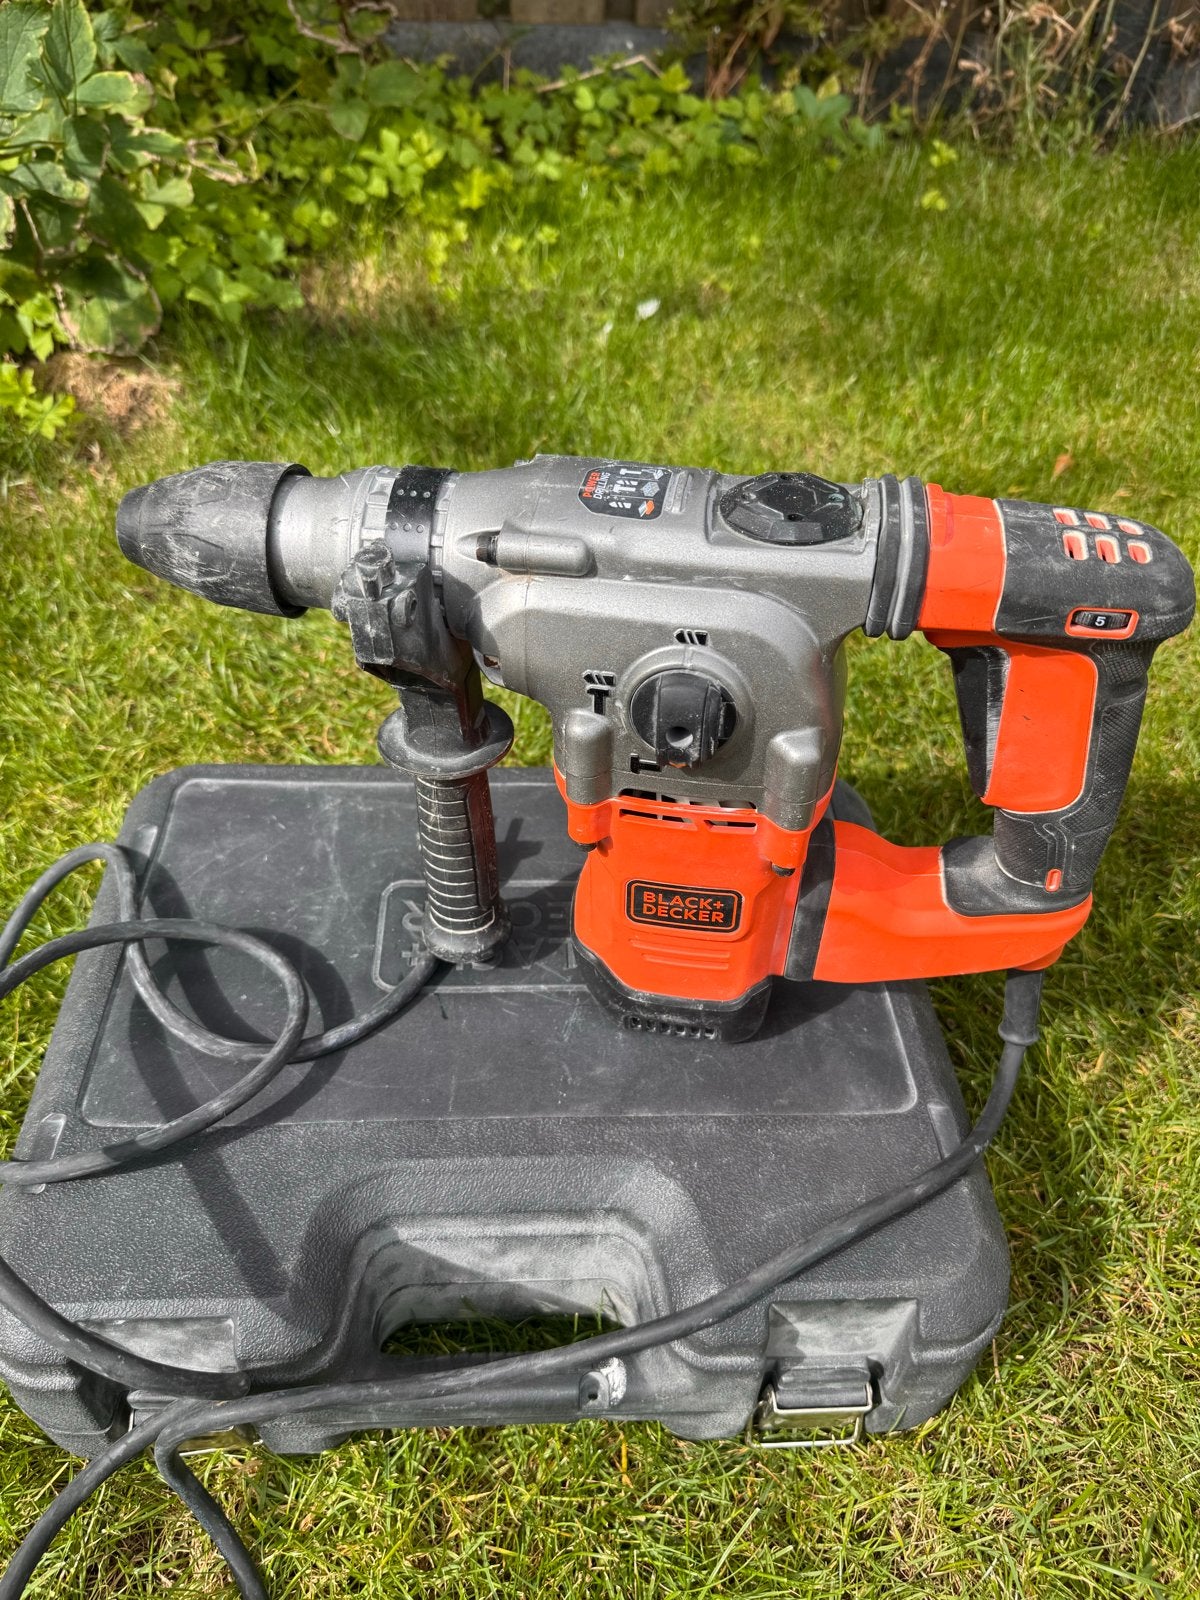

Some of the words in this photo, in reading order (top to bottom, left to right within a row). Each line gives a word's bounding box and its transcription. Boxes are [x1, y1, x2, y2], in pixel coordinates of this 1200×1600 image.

[582, 472, 601, 498] POWER
[593, 472, 611, 500] DRILLING
[1095, 616, 1106, 627] 5
[643, 891, 724, 910] BLACK+
[642, 903, 724, 923] DECKER
